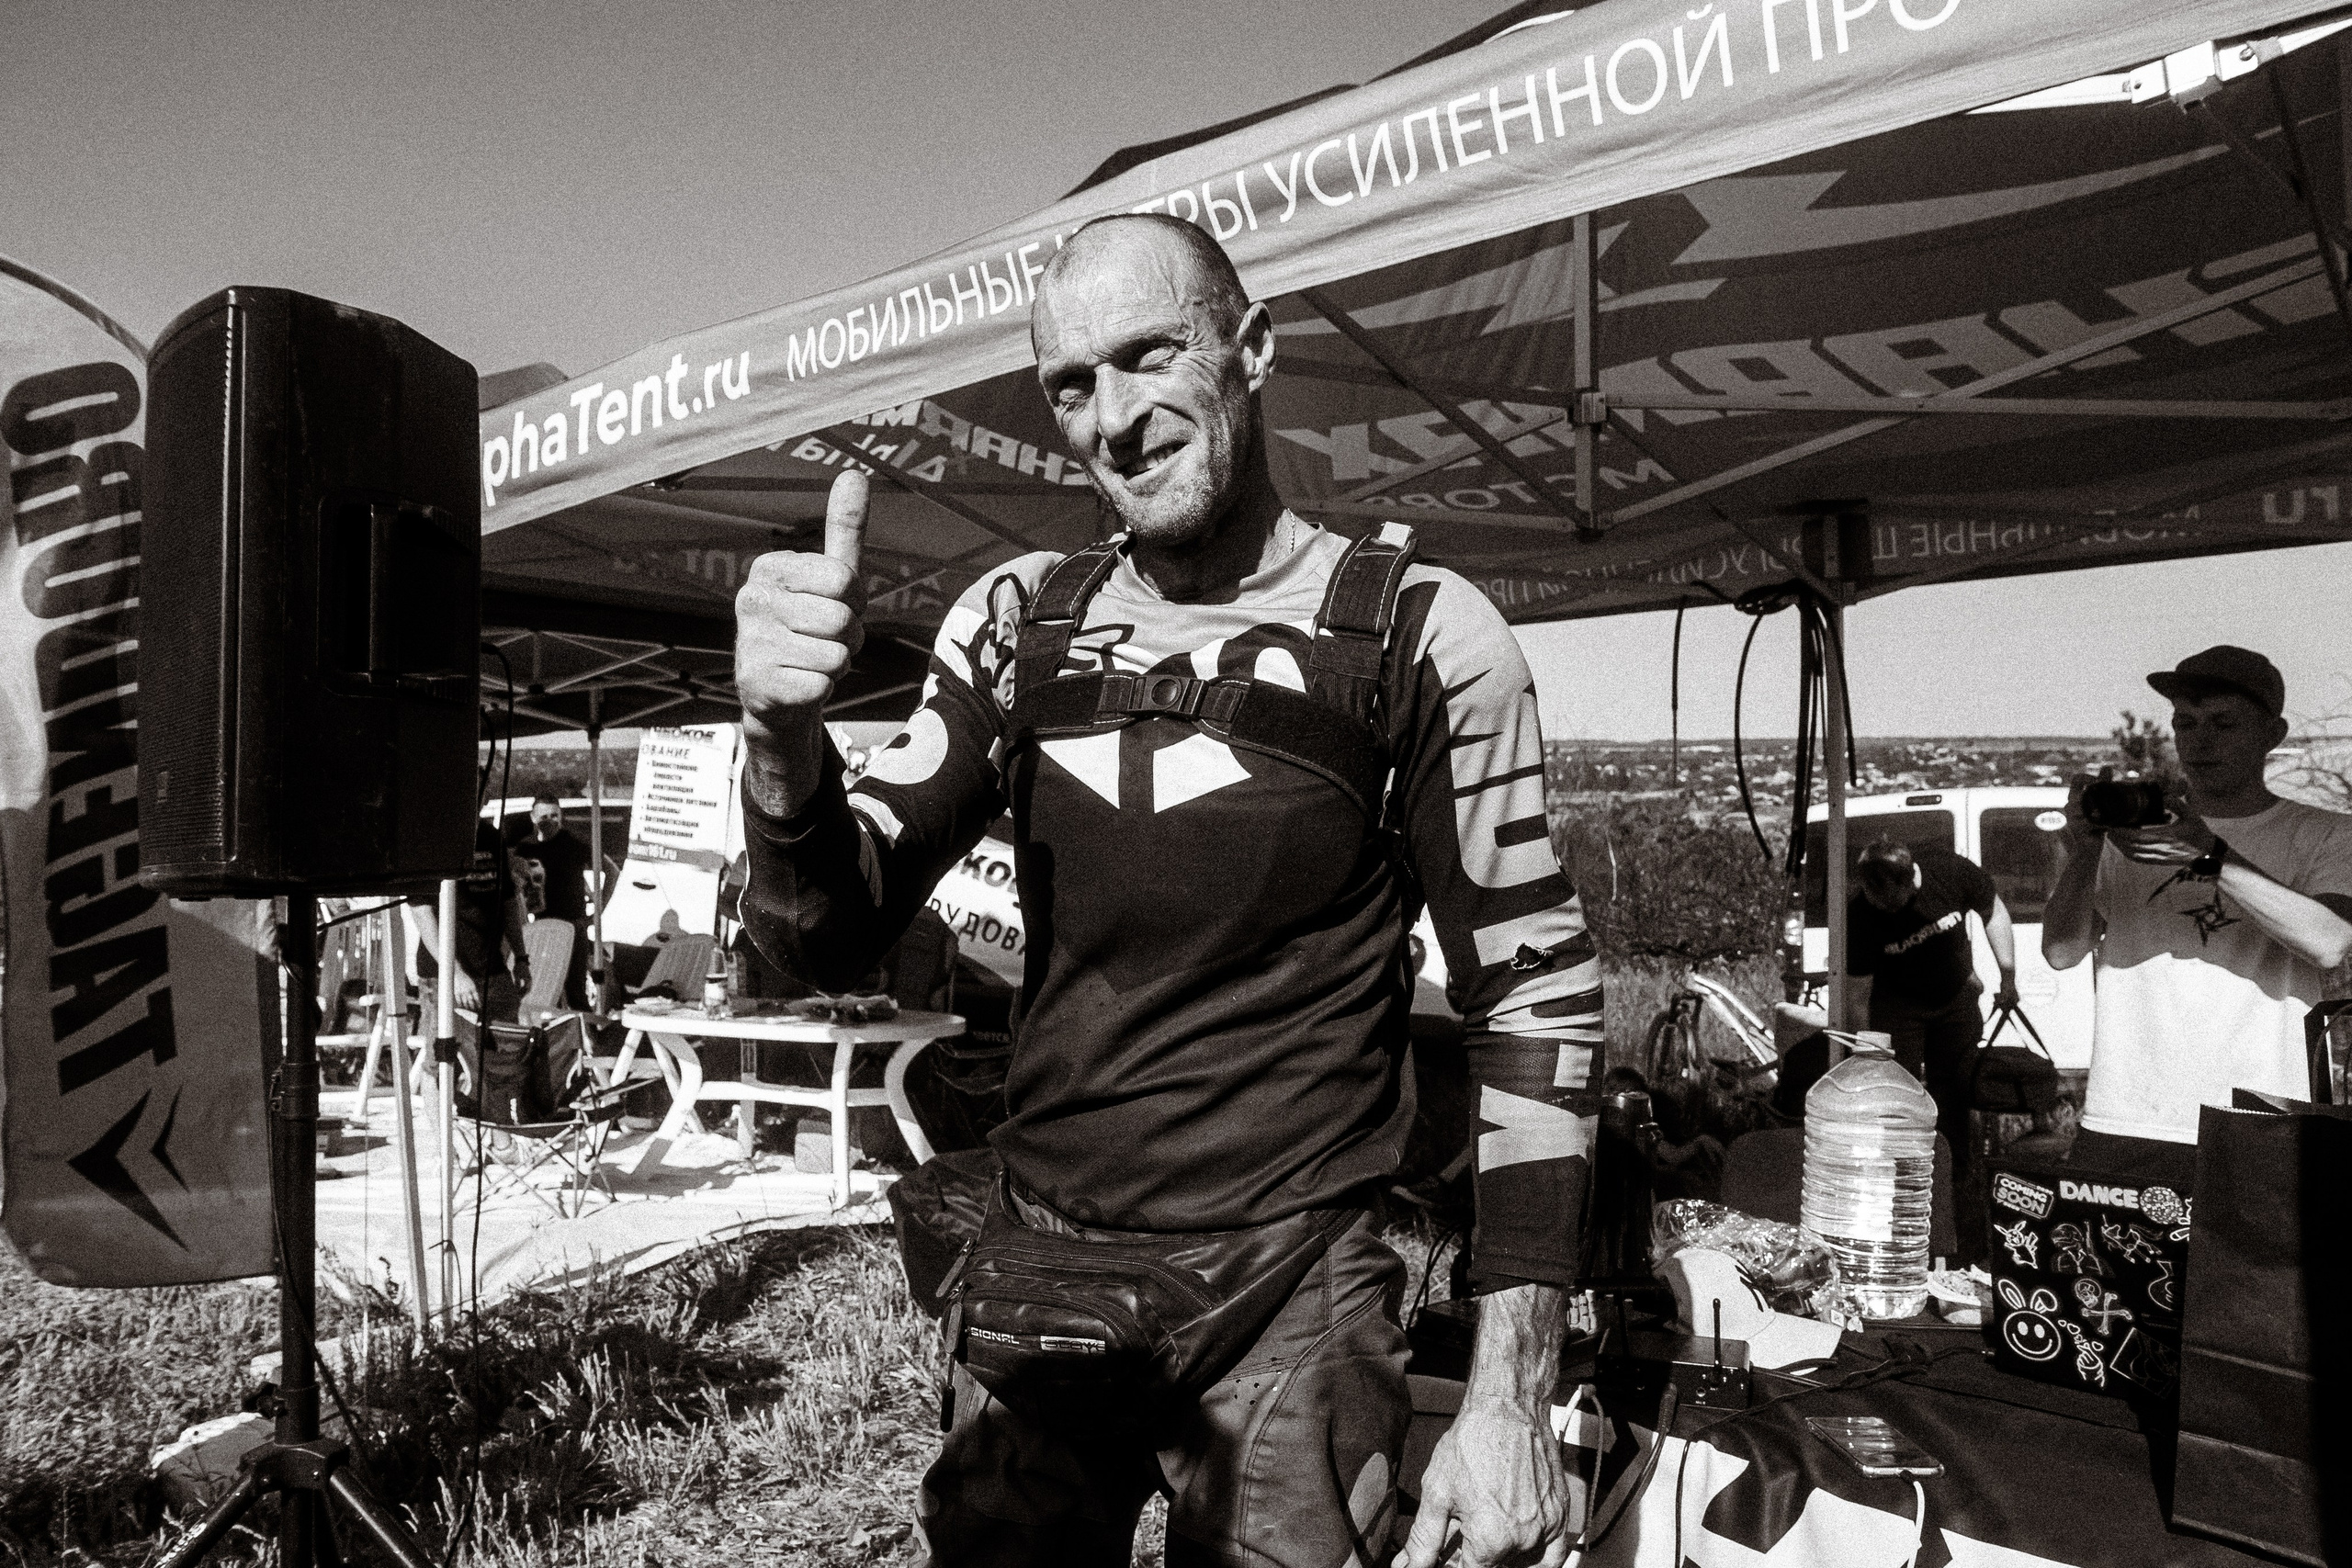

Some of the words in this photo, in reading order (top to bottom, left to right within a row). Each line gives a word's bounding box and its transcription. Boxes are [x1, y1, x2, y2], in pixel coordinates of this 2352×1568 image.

[786, 243, 1045, 382] МОБИЛЬНЫЕ
[1261, 5, 1735, 225] УСИЛЕННОЙ
[1996, 1187, 2046, 1215] SOON
[2000, 1178, 2047, 1203] COMING
[2059, 1179, 2140, 1210] DANCE
